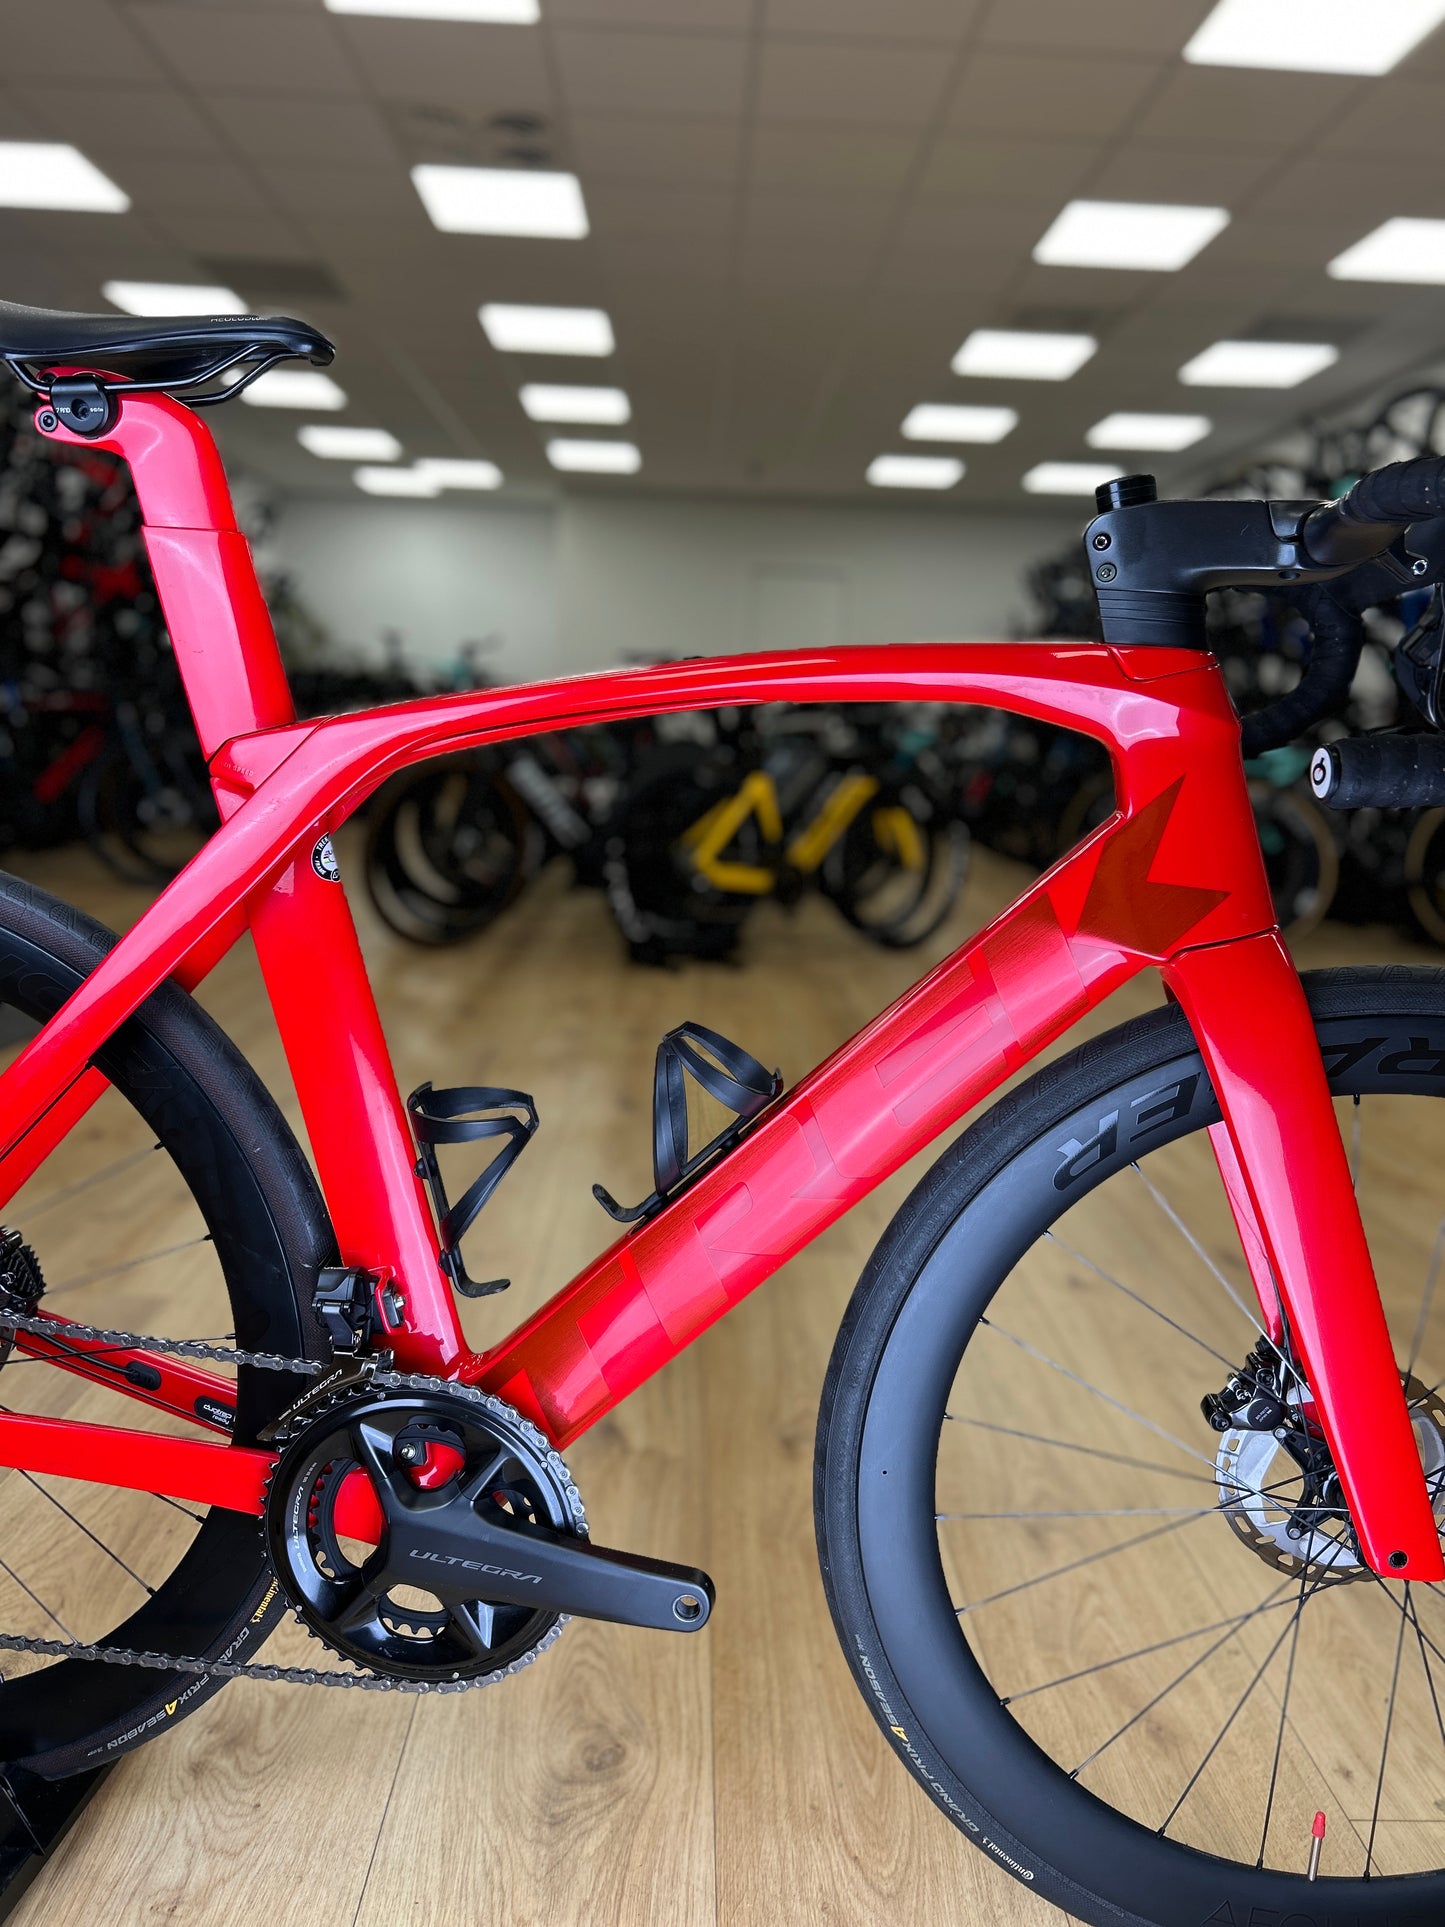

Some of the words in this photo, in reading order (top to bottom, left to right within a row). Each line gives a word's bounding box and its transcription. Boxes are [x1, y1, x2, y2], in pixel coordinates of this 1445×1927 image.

[292, 1368, 343, 1410] ULTEGRA
[292, 1485, 304, 1549] ULTEGRA
[409, 1549, 544, 1584] ULTEGRA
[860, 1654, 899, 1726] SEASON
[902, 1741, 934, 1779] PRIX
[931, 1782, 980, 1832] GRAND
[986, 1841, 1035, 1881] Continental
